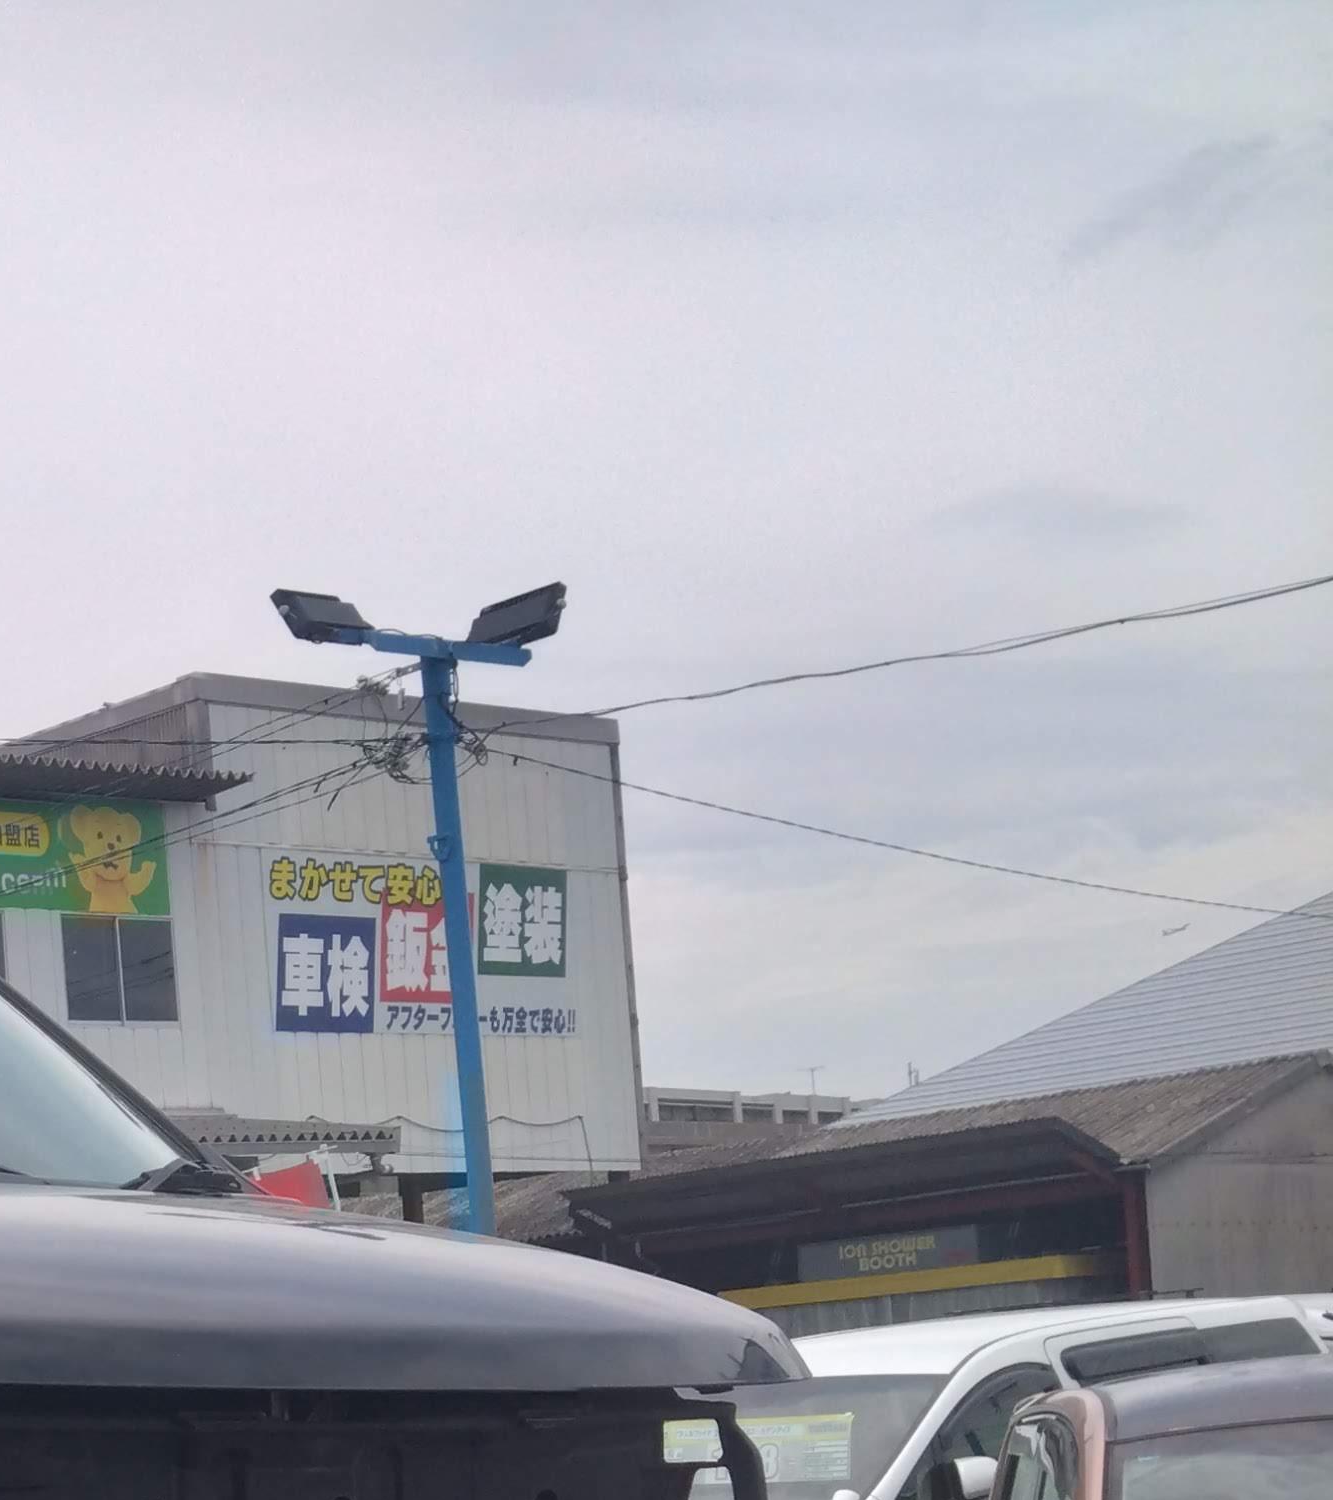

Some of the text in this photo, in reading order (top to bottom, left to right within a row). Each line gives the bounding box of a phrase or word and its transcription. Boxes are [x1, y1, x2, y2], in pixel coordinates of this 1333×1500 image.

[270, 856, 442, 906] まかせて安心
[483, 882, 562, 965] 塗装
[281, 933, 370, 1017] 車検
[859, 1252, 917, 1271] BOOTH
[872, 1235, 936, 1255] SHOWER
